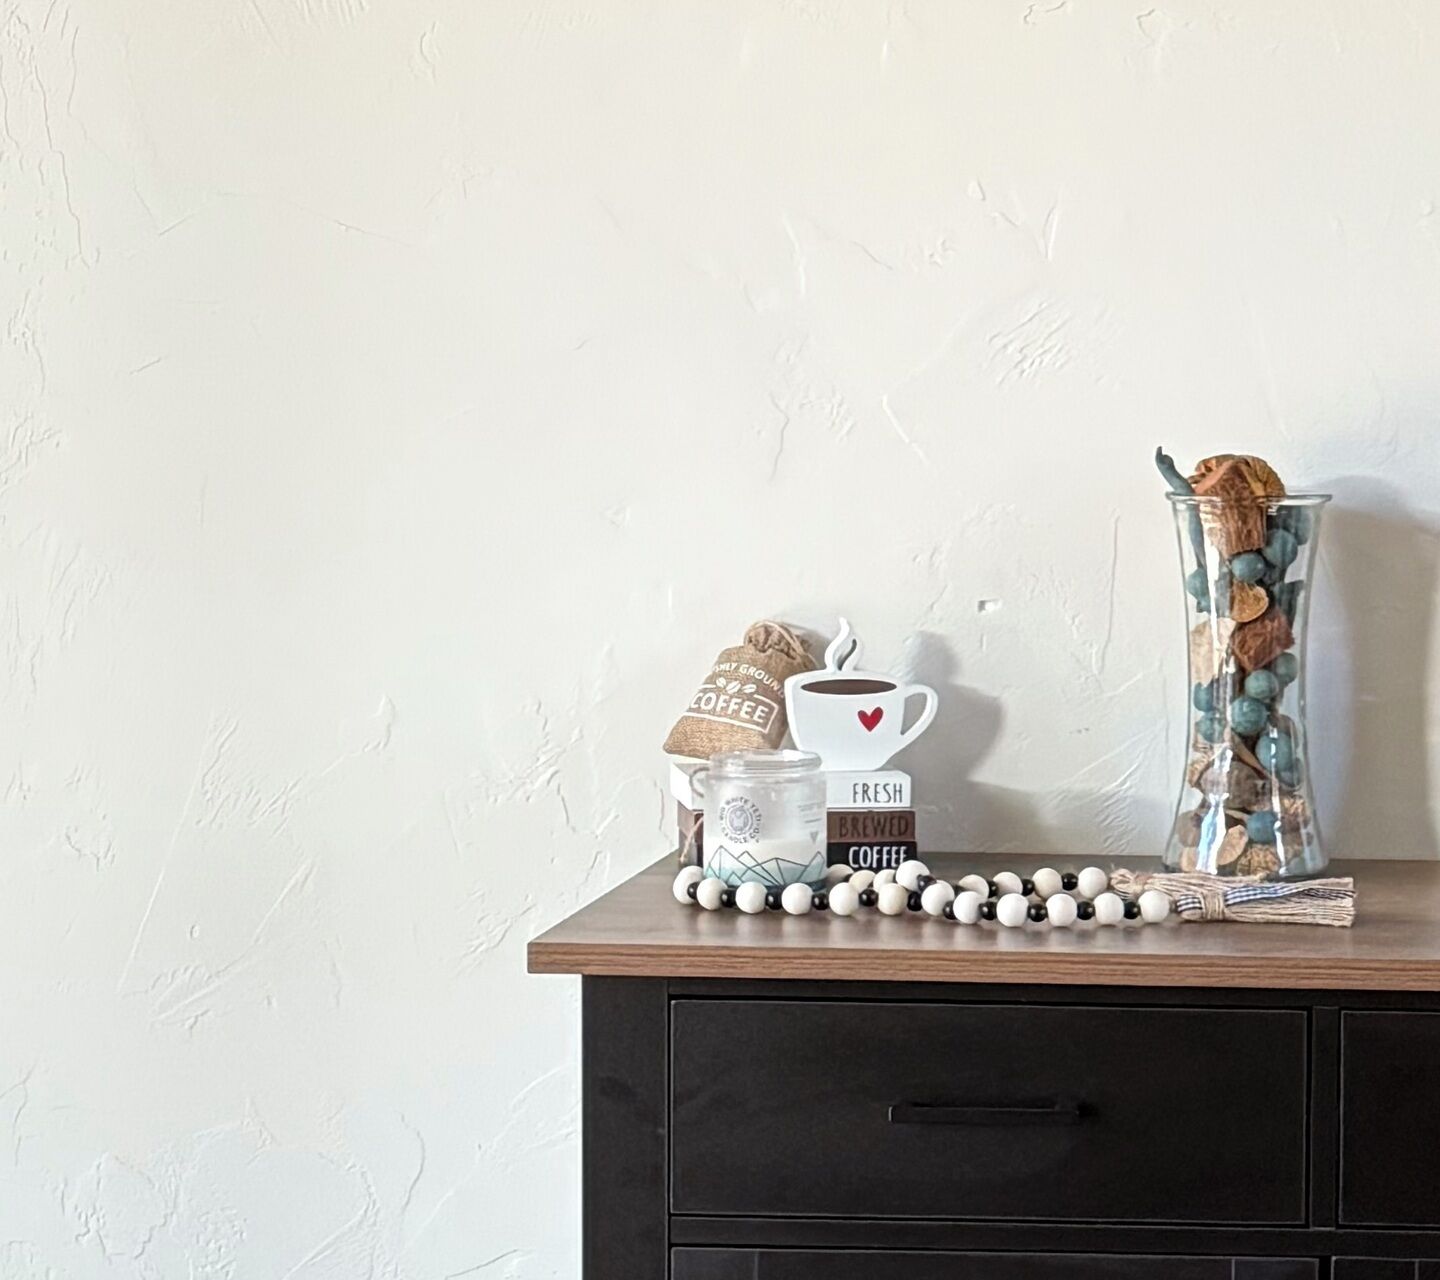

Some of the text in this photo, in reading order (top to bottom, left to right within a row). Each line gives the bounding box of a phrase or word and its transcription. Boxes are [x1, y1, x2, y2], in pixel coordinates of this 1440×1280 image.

[691, 692, 769, 723] COFFEE
[852, 783, 903, 803] FRESH
[839, 815, 909, 838] BREWED
[848, 846, 908, 868] COFFEE
